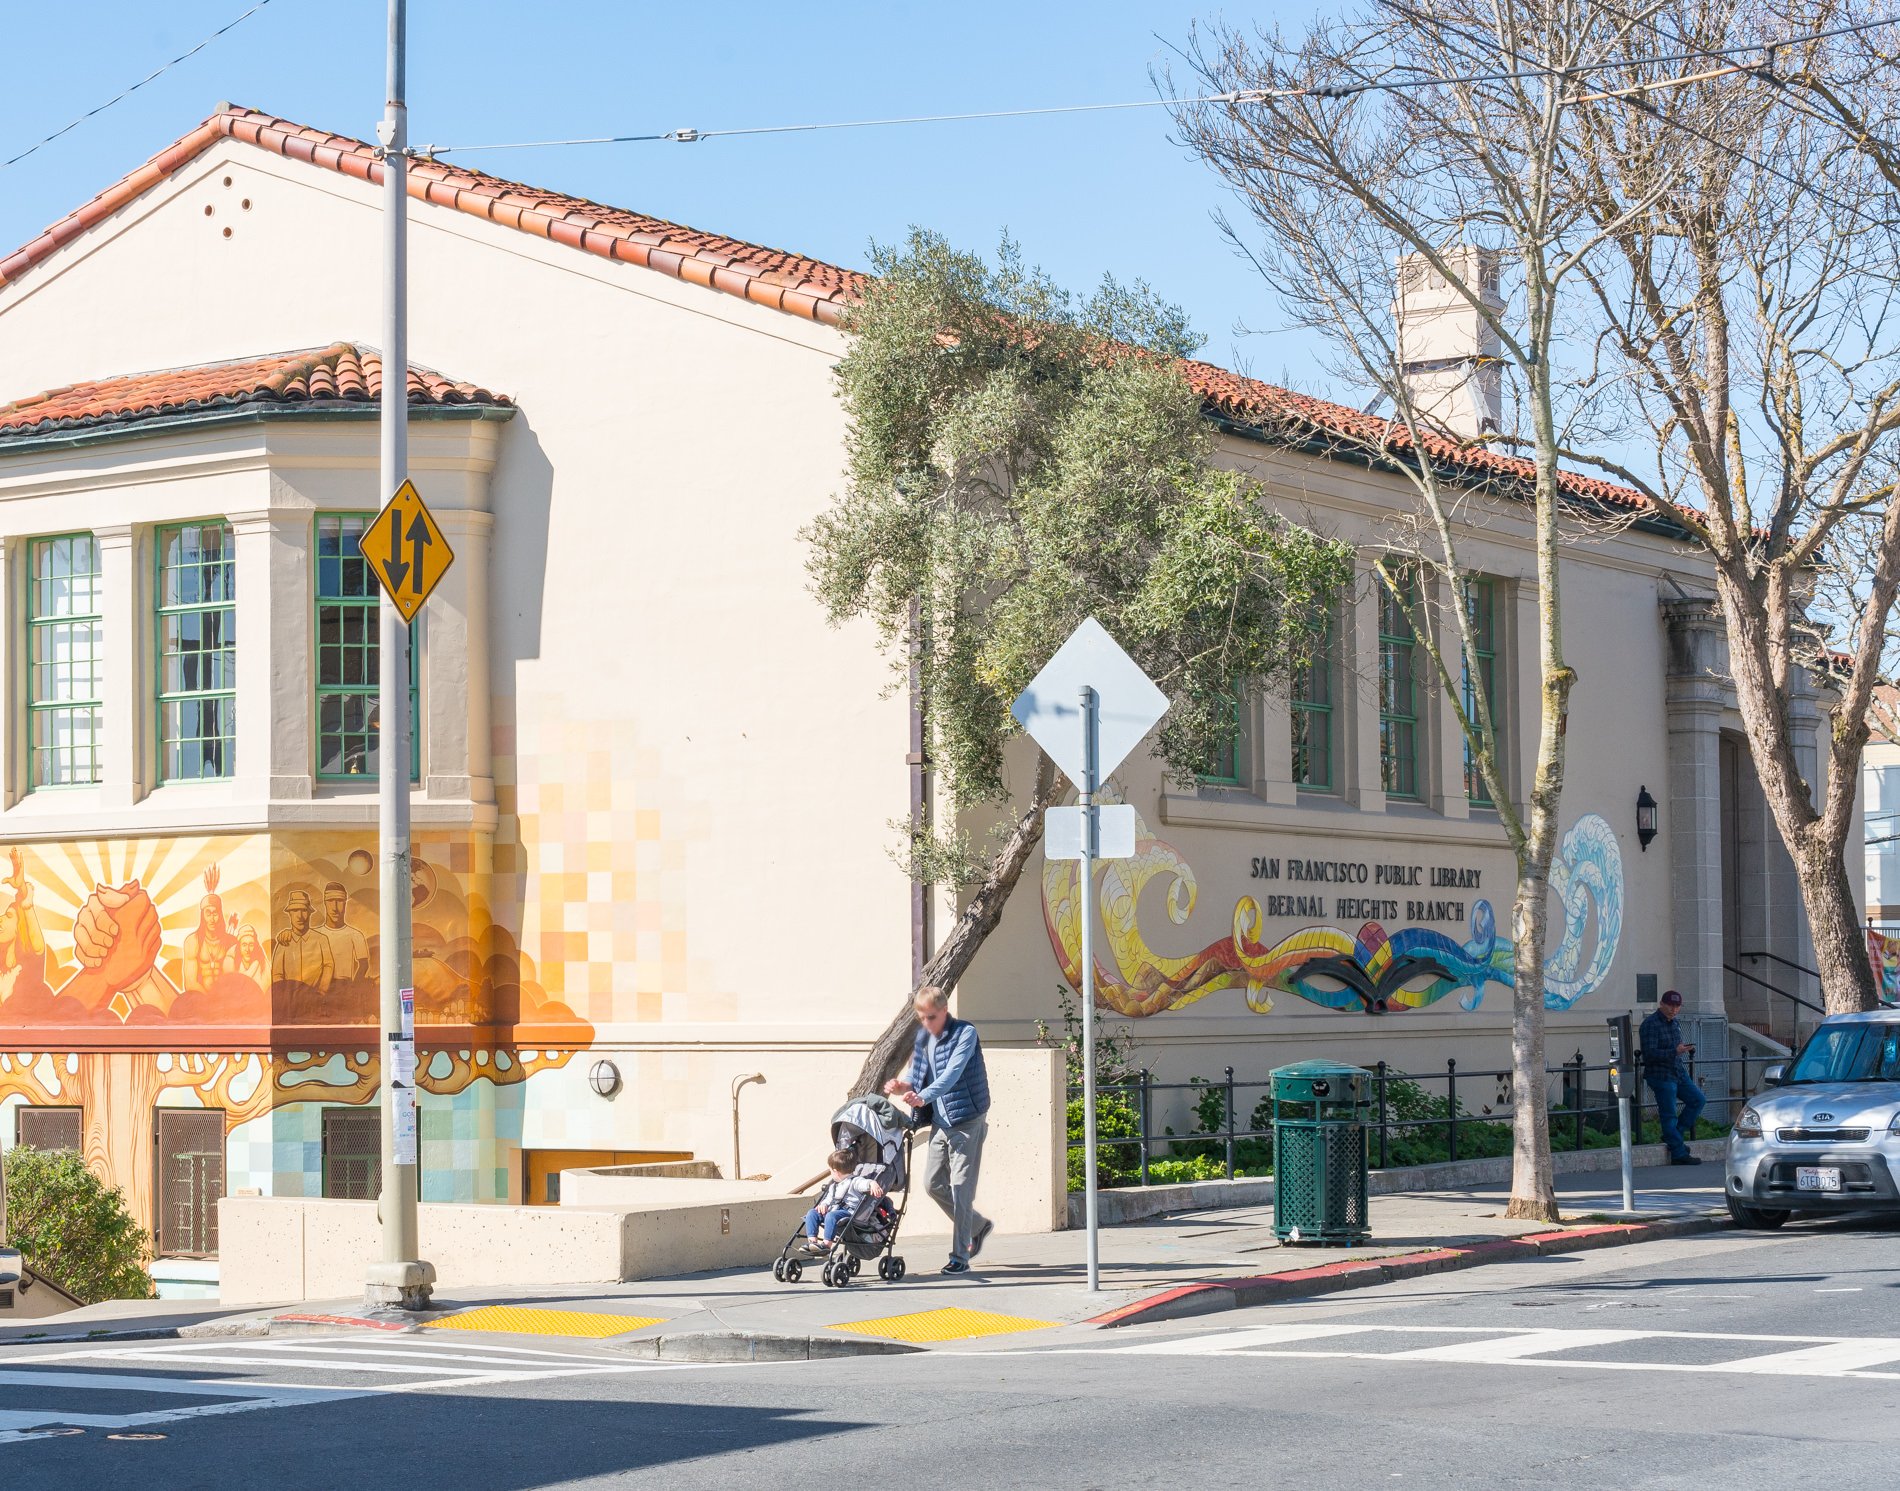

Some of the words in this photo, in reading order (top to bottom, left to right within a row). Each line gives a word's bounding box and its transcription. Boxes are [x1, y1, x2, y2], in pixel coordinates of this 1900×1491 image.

[1250, 856, 1280, 879] SAN
[1287, 859, 1368, 883] FRANCISCO
[1375, 864, 1423, 886] PUBLIC
[1430, 867, 1482, 889] LIBRARY
[1268, 894, 1328, 917] BERNAL
[1336, 898, 1398, 920] HEIGHTS
[1406, 900, 1464, 922] BRANCH
[1800, 1175, 1836, 1187] 6TED075
